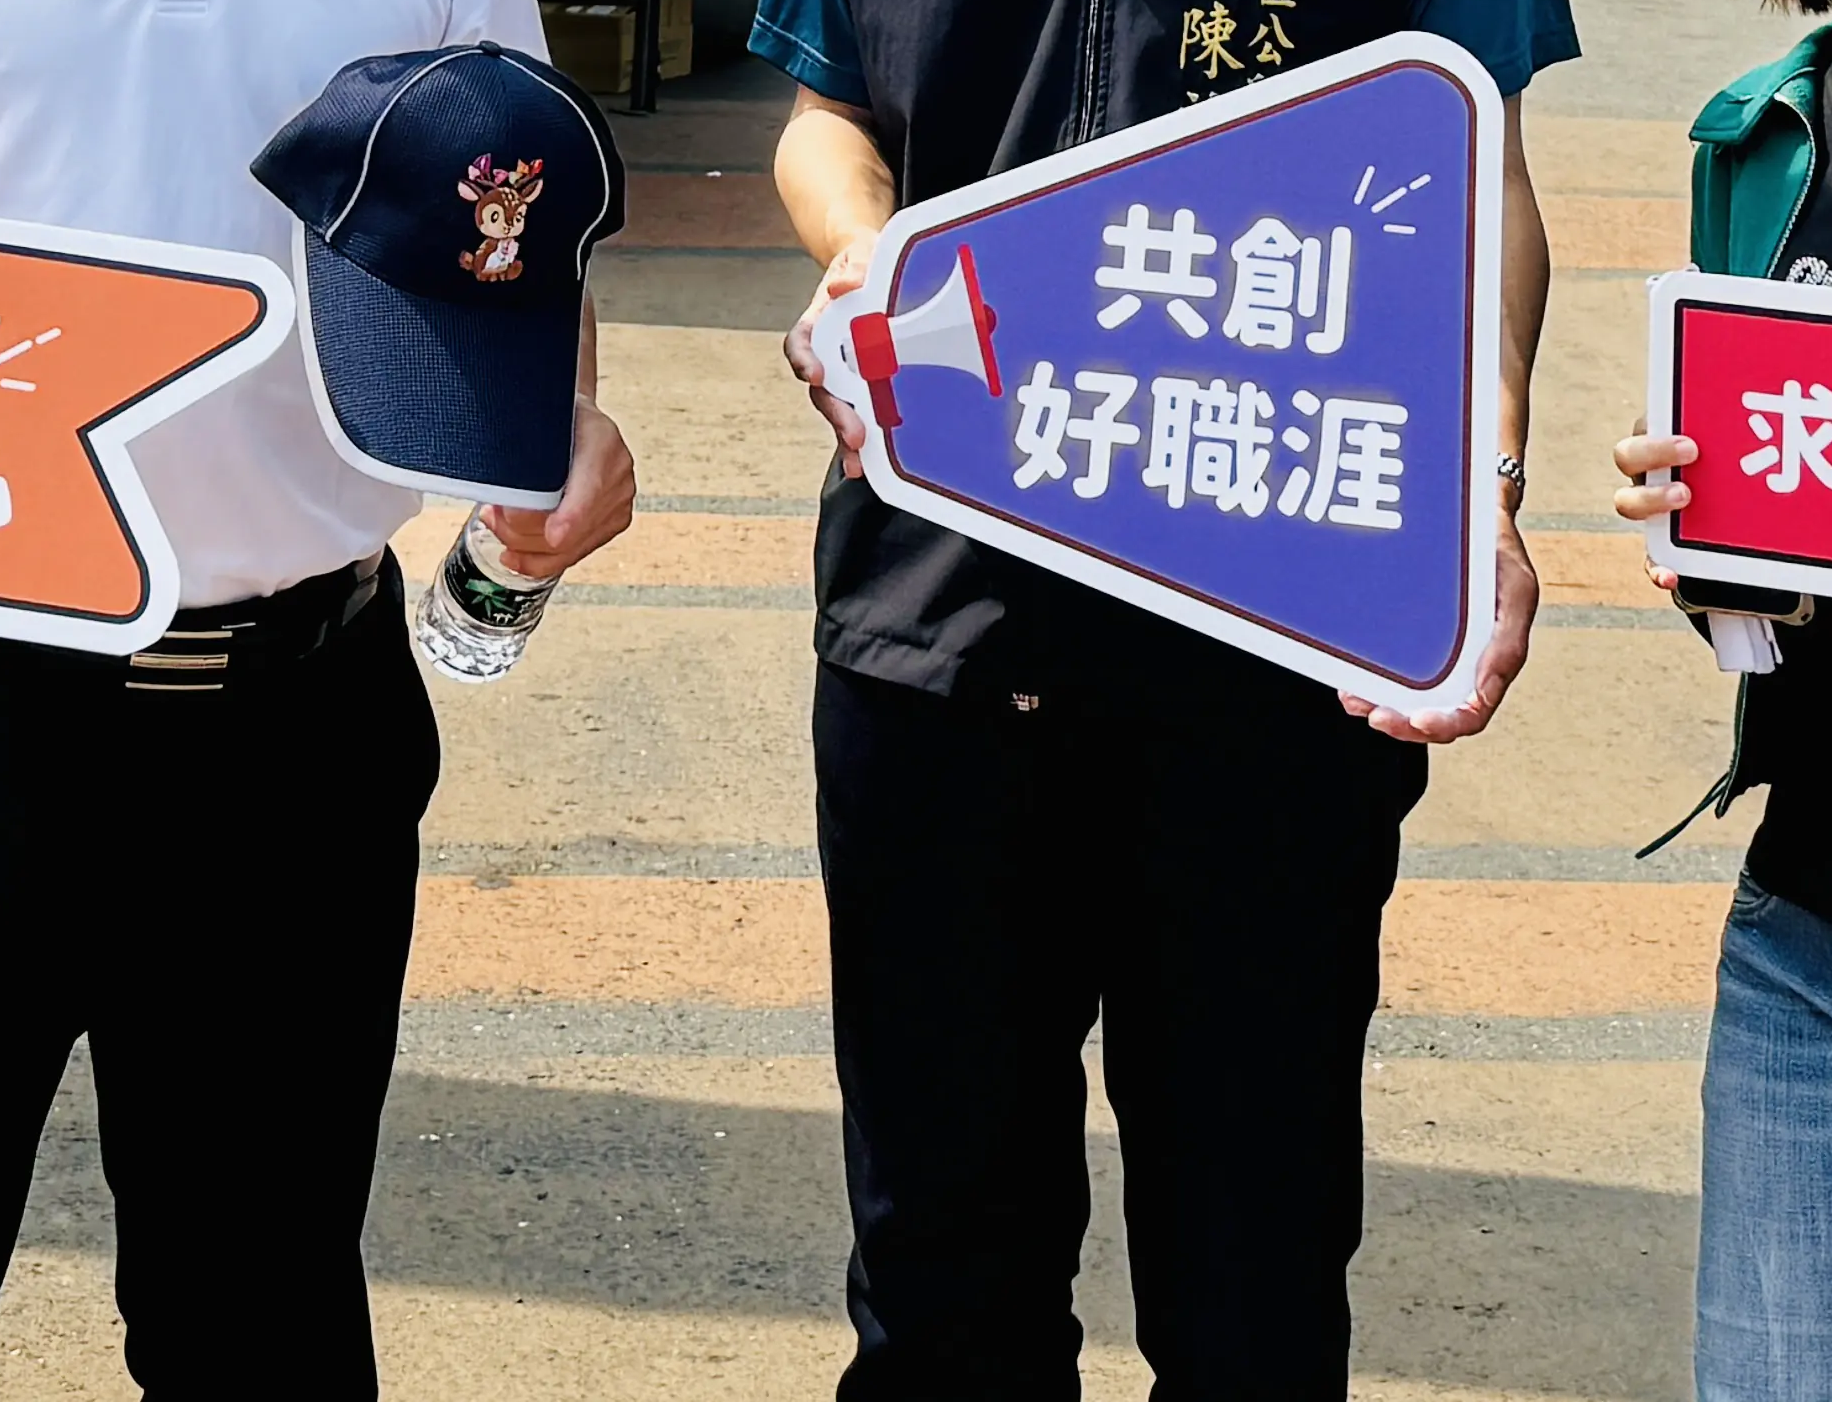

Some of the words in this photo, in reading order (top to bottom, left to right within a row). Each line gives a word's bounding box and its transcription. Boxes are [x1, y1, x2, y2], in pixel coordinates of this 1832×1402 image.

[1092, 203, 1354, 356] 共創
[1011, 360, 1410, 532] 好職涯
